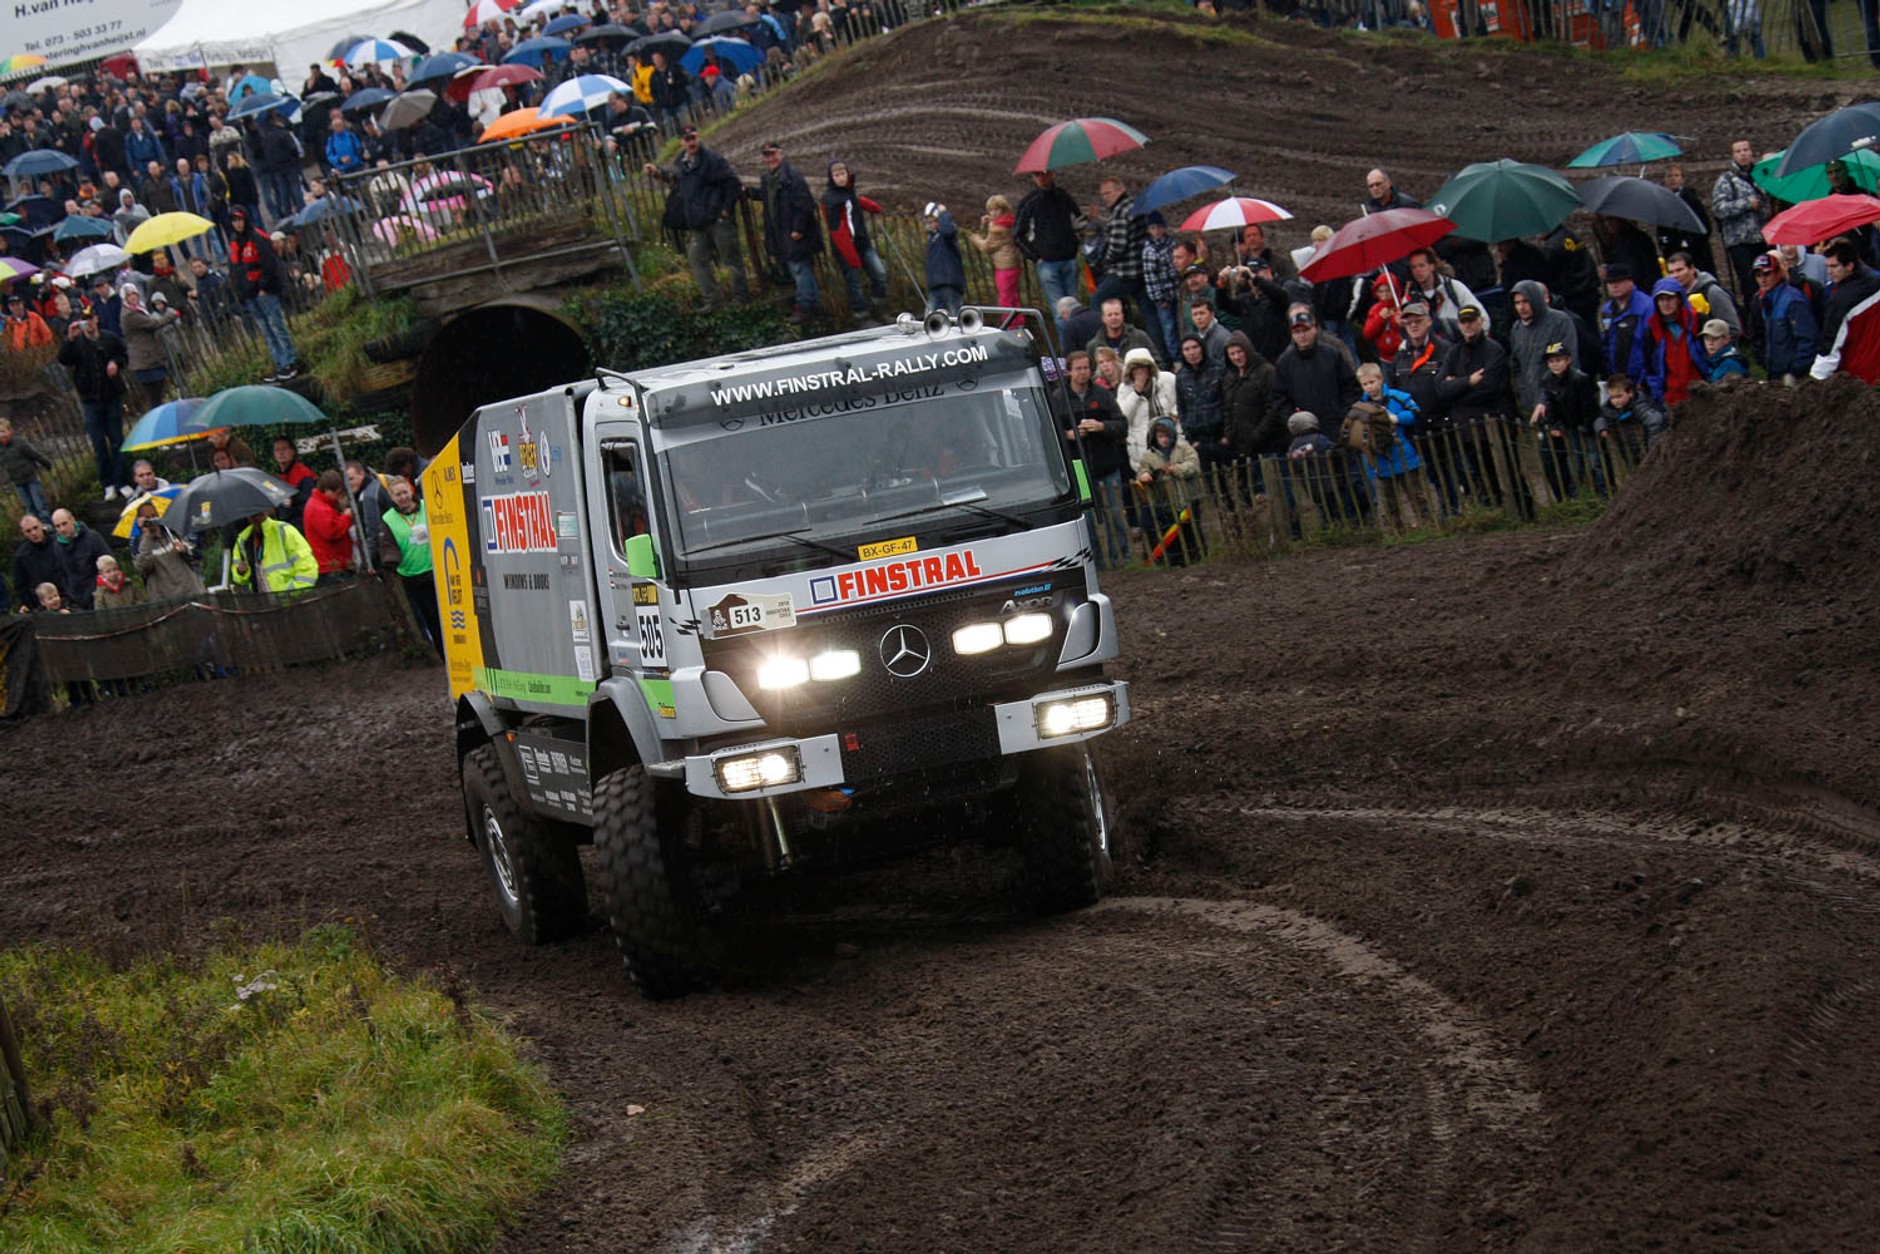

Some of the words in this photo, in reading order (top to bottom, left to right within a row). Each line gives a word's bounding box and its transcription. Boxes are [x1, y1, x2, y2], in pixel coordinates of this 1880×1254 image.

[45, 35, 64, 47] 073
[73, 28, 92, 40] 503
[95, 24, 107, 35] 33
[110, 20, 122, 30] 77
[711, 345, 989, 407] WWW.FINSTRAL-RALLY.COM
[493, 494, 557, 551] FINSTRAL
[863, 540, 913, 557] BX-GF-47
[534, 573, 550, 590] DOORS
[837, 550, 981, 600] FINSTRAL
[735, 607, 761, 624] 513
[638, 615, 664, 659] 505
